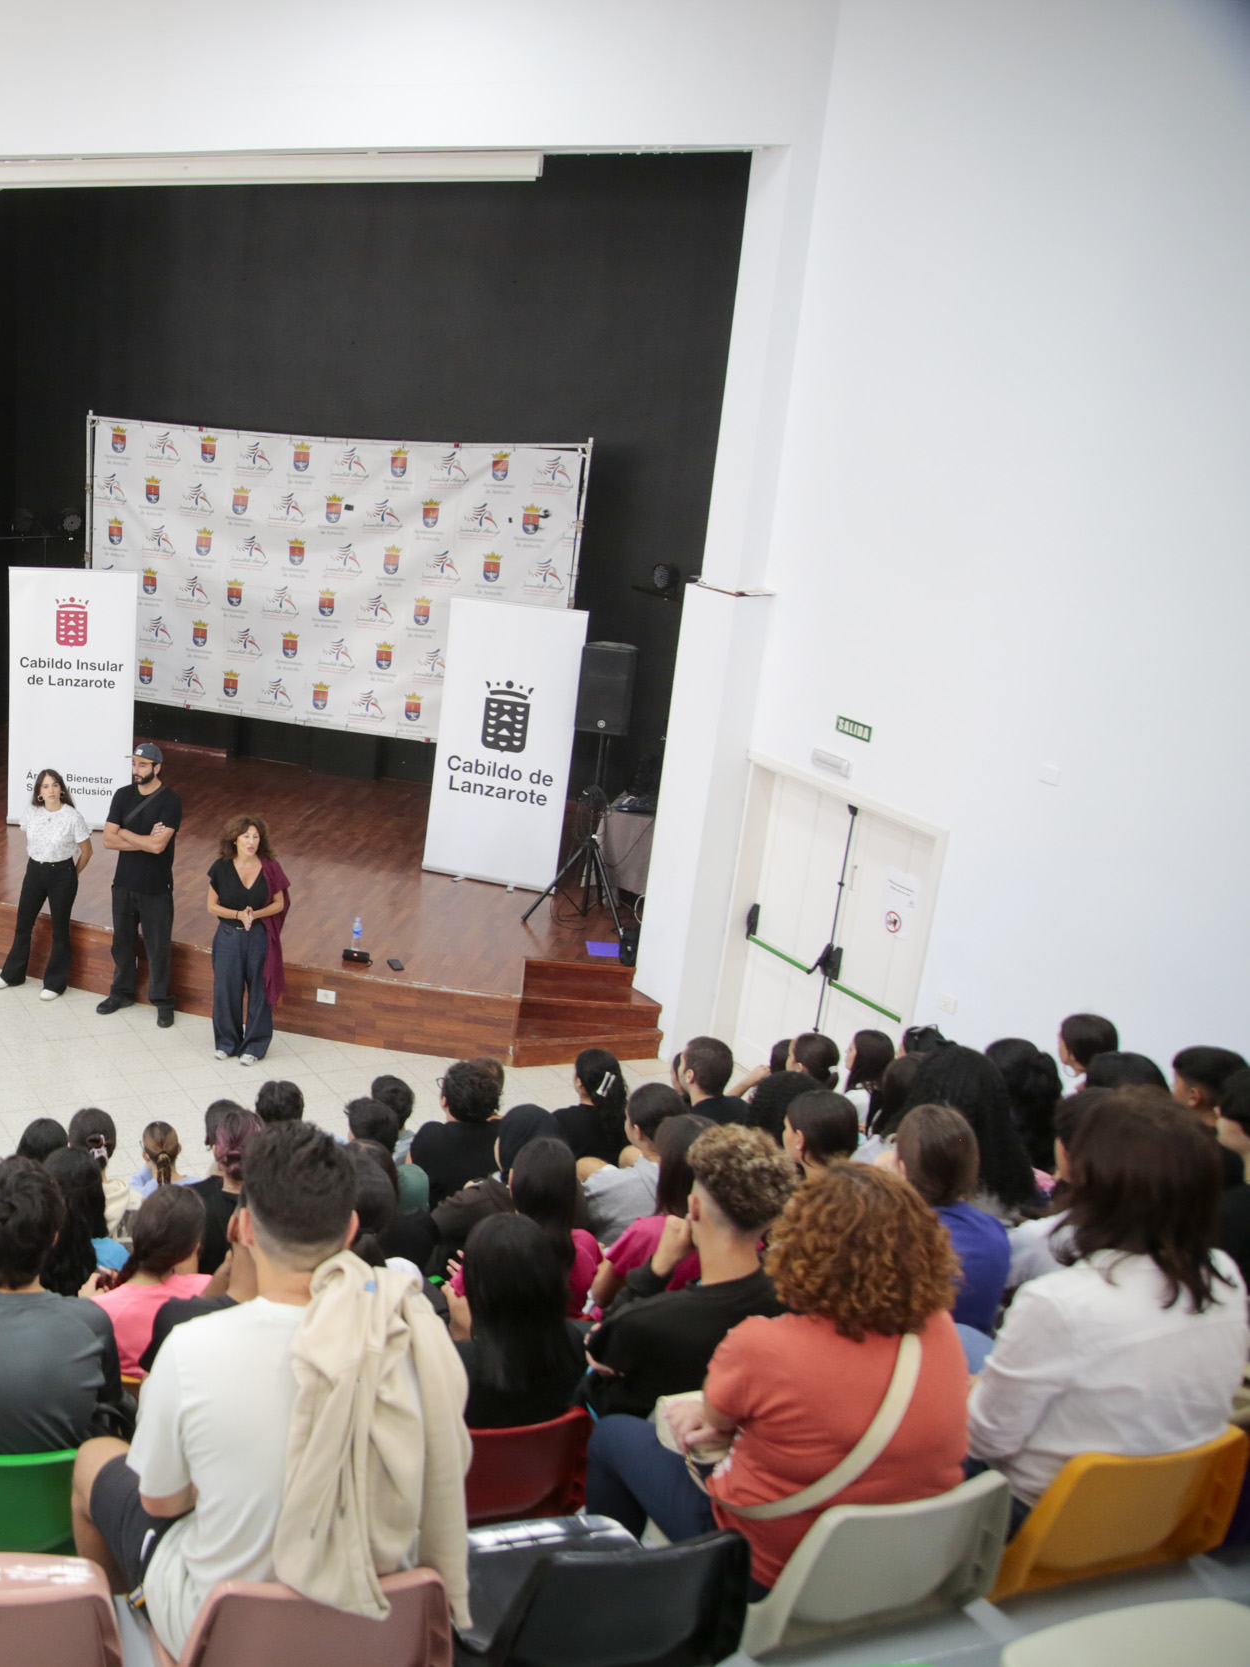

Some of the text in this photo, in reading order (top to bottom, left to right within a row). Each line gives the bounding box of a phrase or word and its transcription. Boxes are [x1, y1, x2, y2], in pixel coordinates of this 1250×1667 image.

[19, 656, 124, 672] Cabildo Insular
[27, 674, 116, 689] de Lanzarote
[838, 718, 870, 740] SALIDA
[66, 774, 114, 784] Bienestar
[447, 754, 554, 786] Cabildo de
[448, 774, 548, 806] Lanzarote
